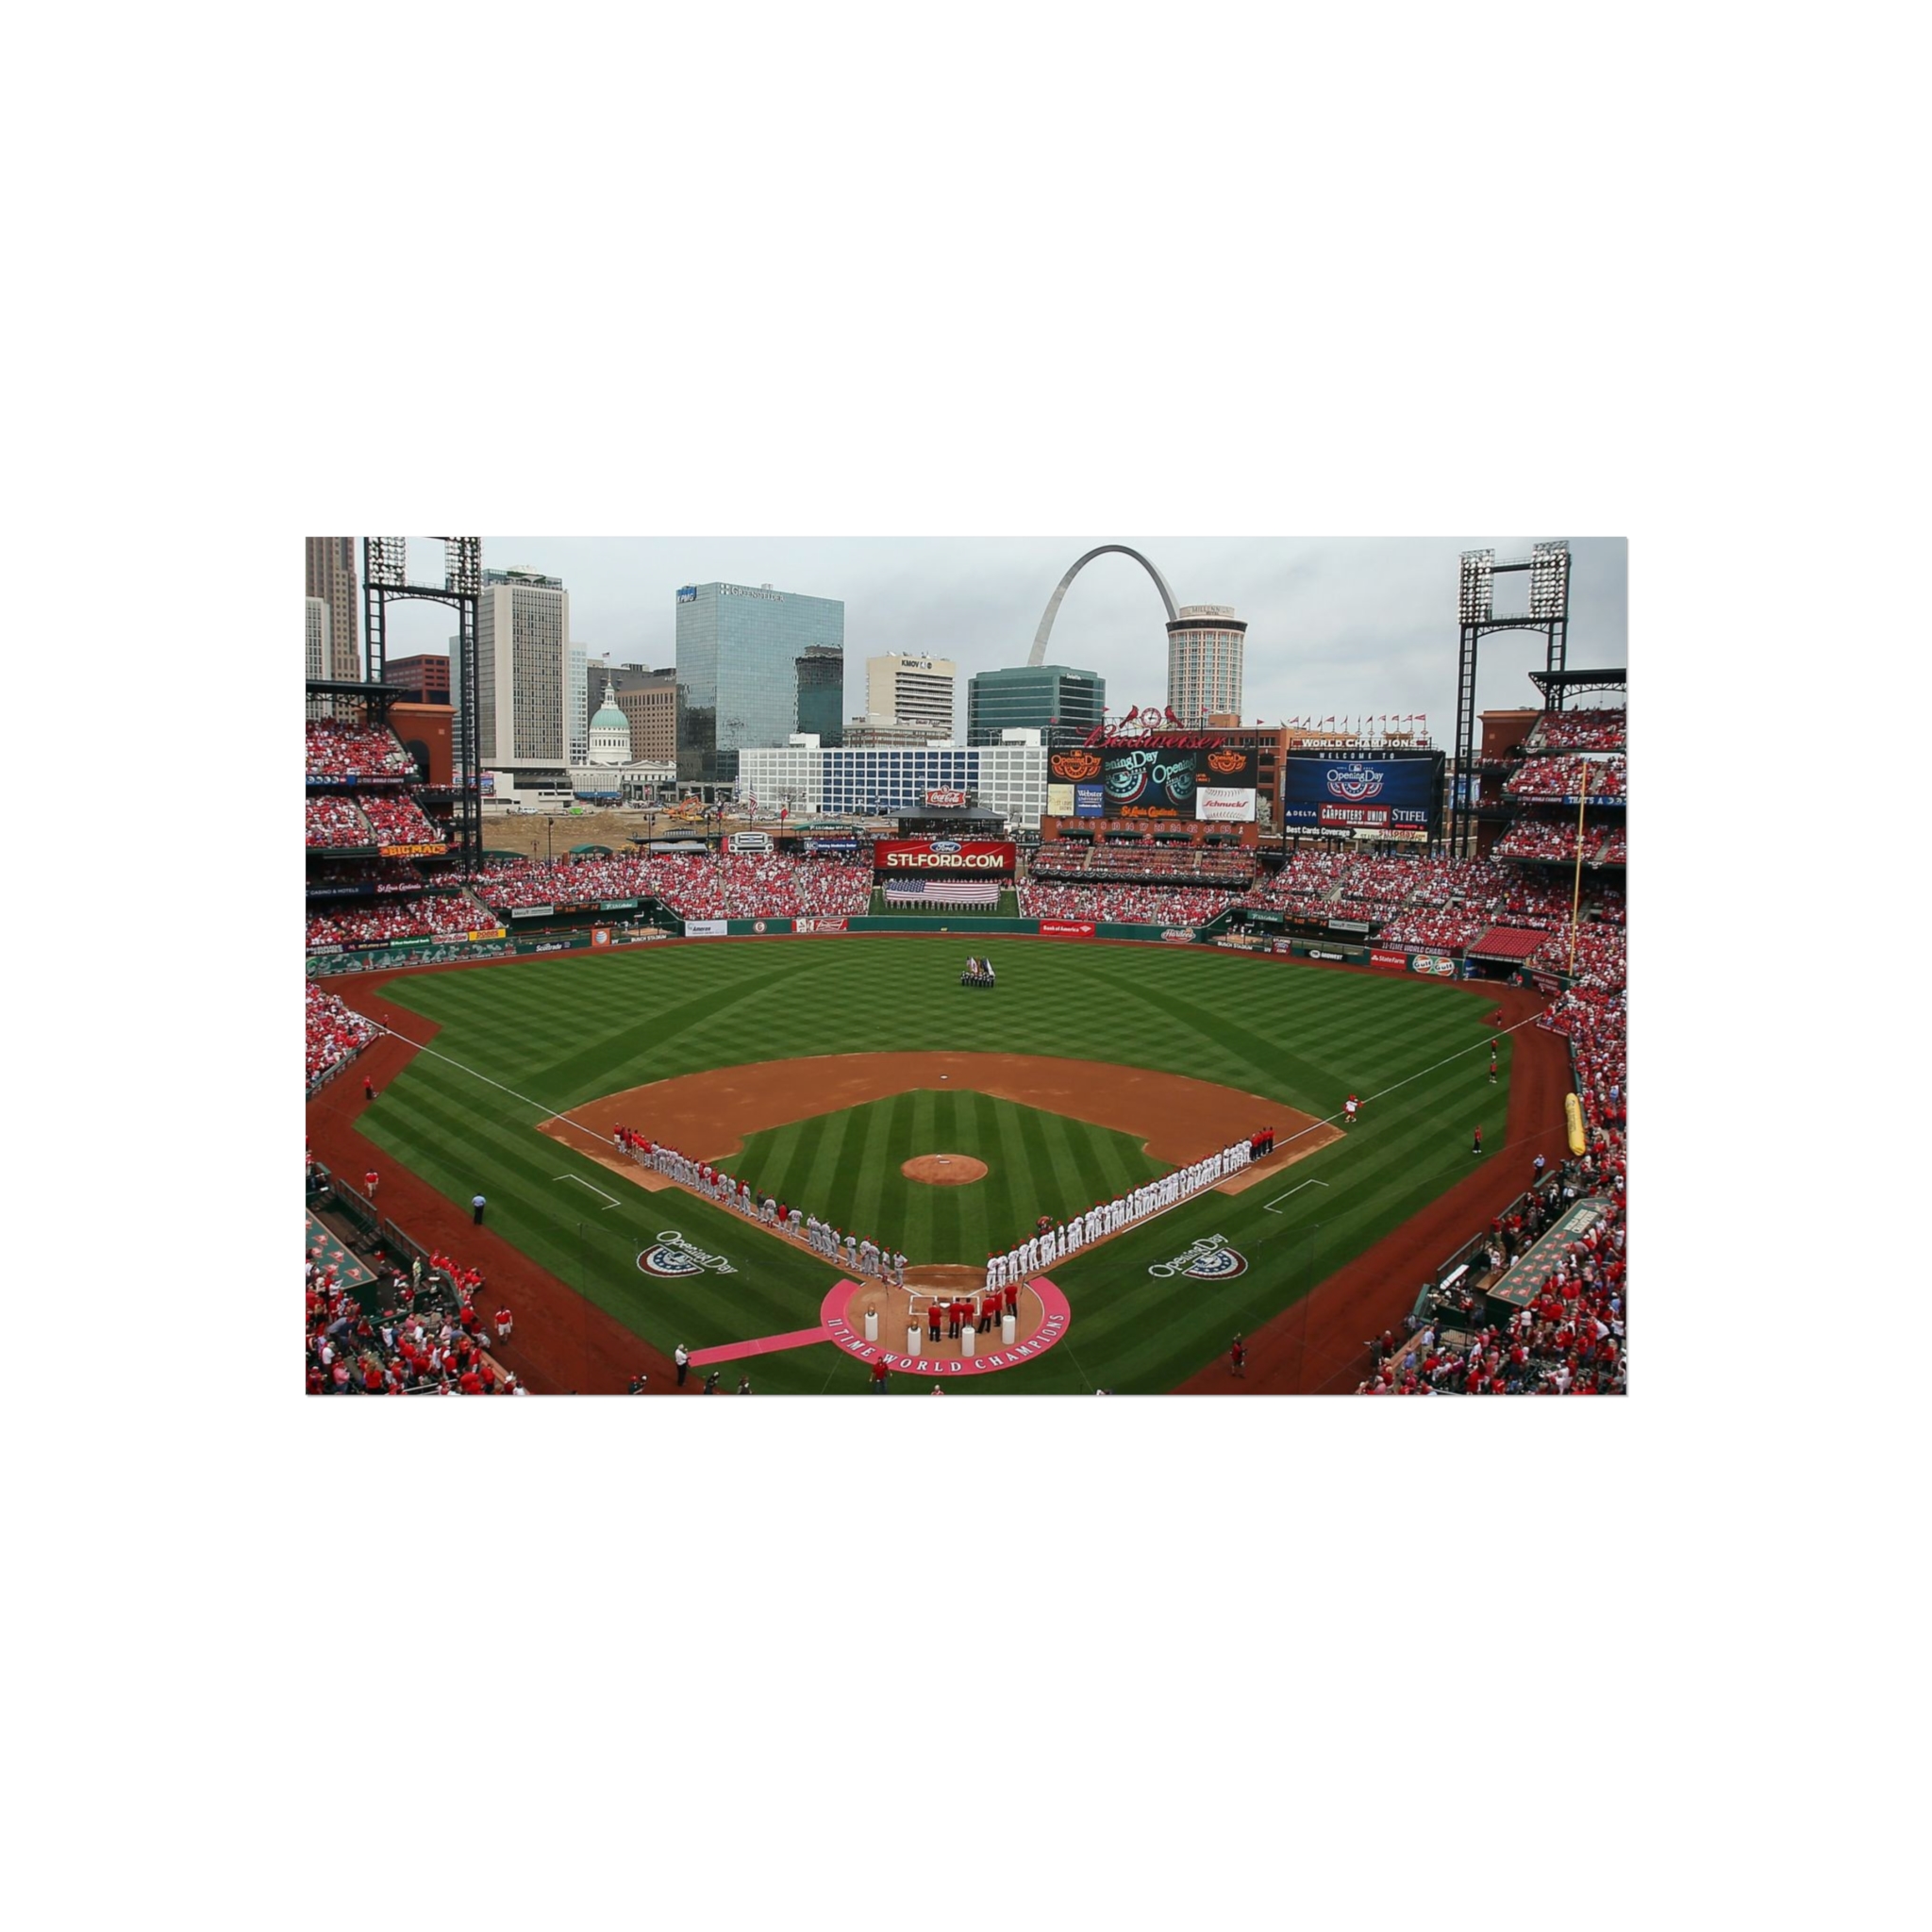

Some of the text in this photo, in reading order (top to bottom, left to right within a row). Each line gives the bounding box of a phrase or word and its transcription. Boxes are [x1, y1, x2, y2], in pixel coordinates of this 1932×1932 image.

[676, 593, 694, 603] KPMG
[901, 659, 920, 668] KMOV
[1076, 724, 1227, 750] Budweiser
[1302, 739, 1418, 748] WORLD CHAMPIONS
[931, 792, 960, 804] Coca-Cola
[1203, 800, 1249, 808] Schnucks
[1322, 808, 1388, 822] CARPENTERS' UNION
[1391, 808, 1428, 822] STIFEL
[1078, 821, 1084, 829] 2
[1100, 821, 1107, 830] 9
[1111, 822, 1120, 830] 10
[1140, 822, 1148, 831] 17
[1170, 824, 1181, 832] 24
[1187, 824, 1198, 833] 42
[1203, 824, 1214, 833] 45
[1220, 825, 1231, 834] 85
[1286, 825, 1351, 838] Best Cards Coverage
[389, 845, 441, 855] BIG MAC
[887, 853, 1004, 868] STLFORD.COM
[536, 943, 562, 952] Scottrade
[1382, 942, 1452, 957] 11-TIME WORLD CHAMPS
[1321, 952, 1343, 960] MIDWEST
[834, 1328, 874, 1357] TIME
[881, 1353, 962, 1373] WORLD
[974, 1313, 1065, 1371] CHAMPIONS
